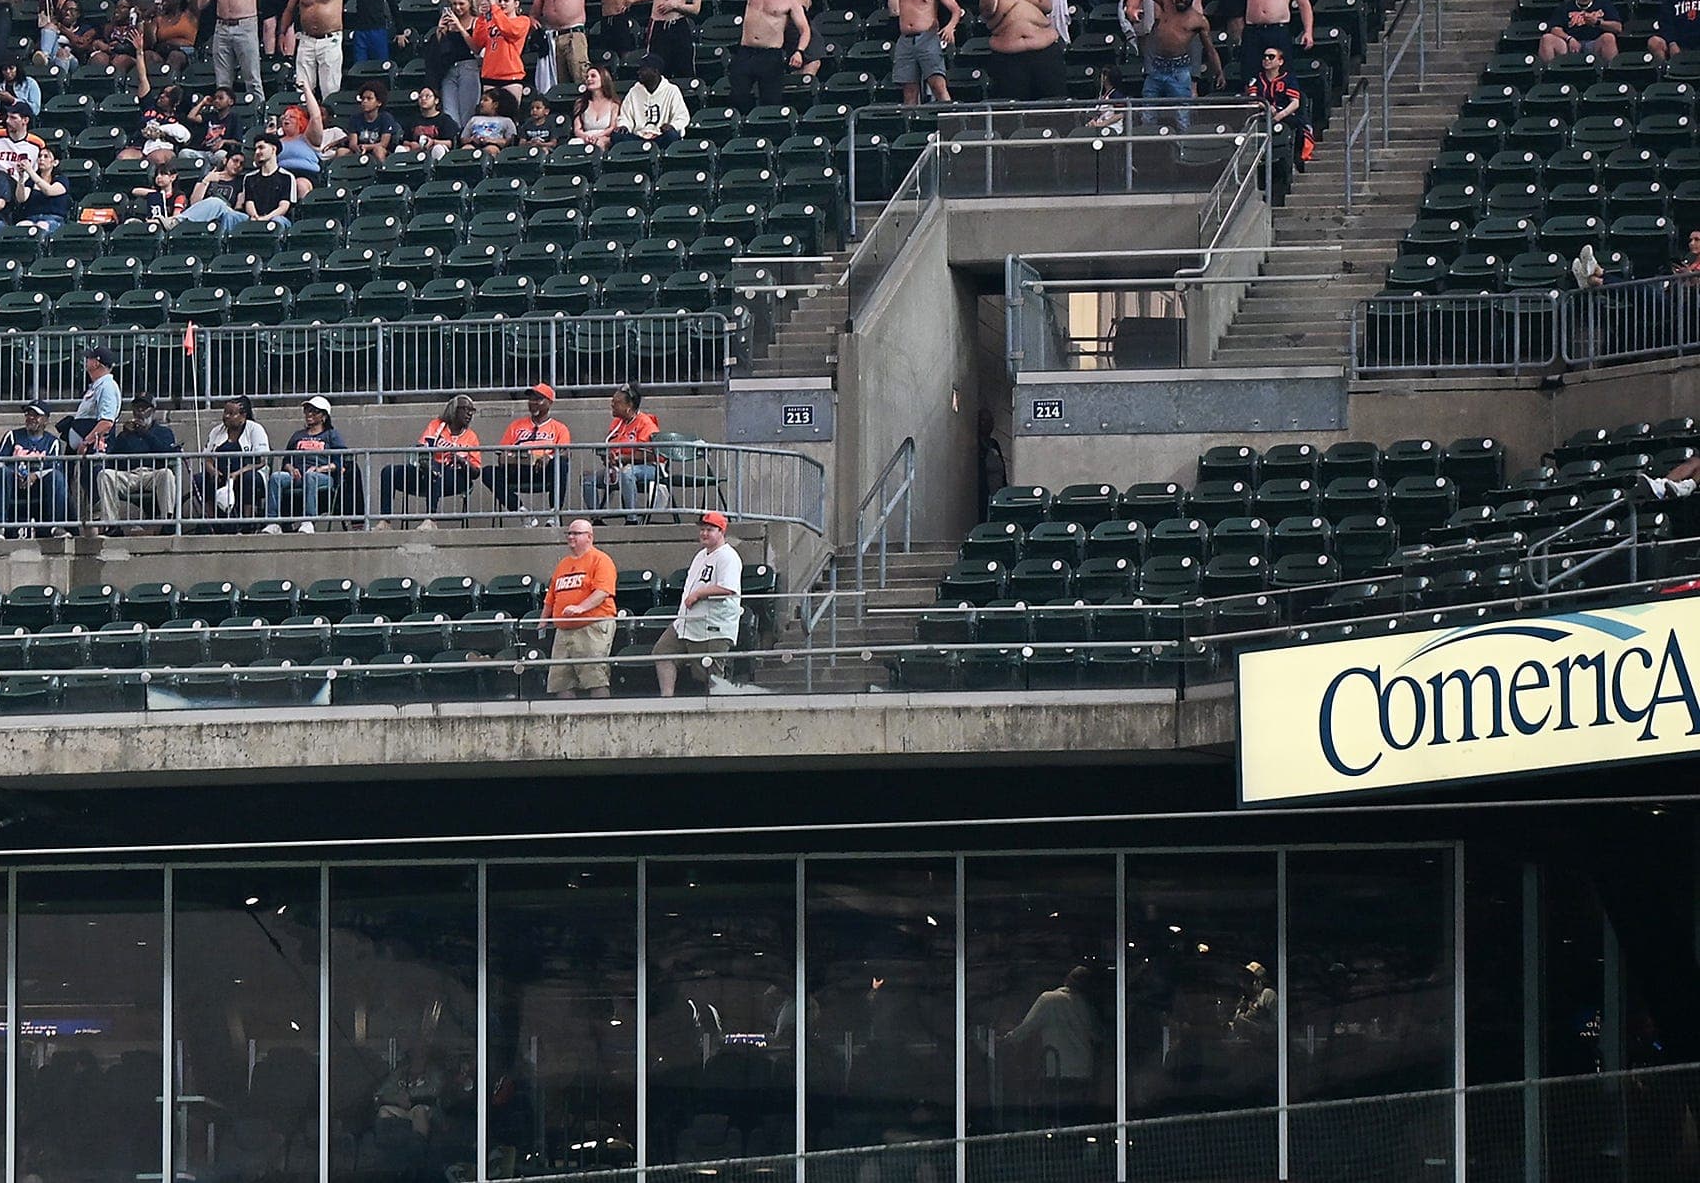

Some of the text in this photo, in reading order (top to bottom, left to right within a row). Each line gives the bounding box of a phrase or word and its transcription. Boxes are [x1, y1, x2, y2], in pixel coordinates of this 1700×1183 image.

[1674, 0, 1700, 16] TIGE
[787, 412, 810, 424] 213
[1036, 406, 1060, 418] 214
